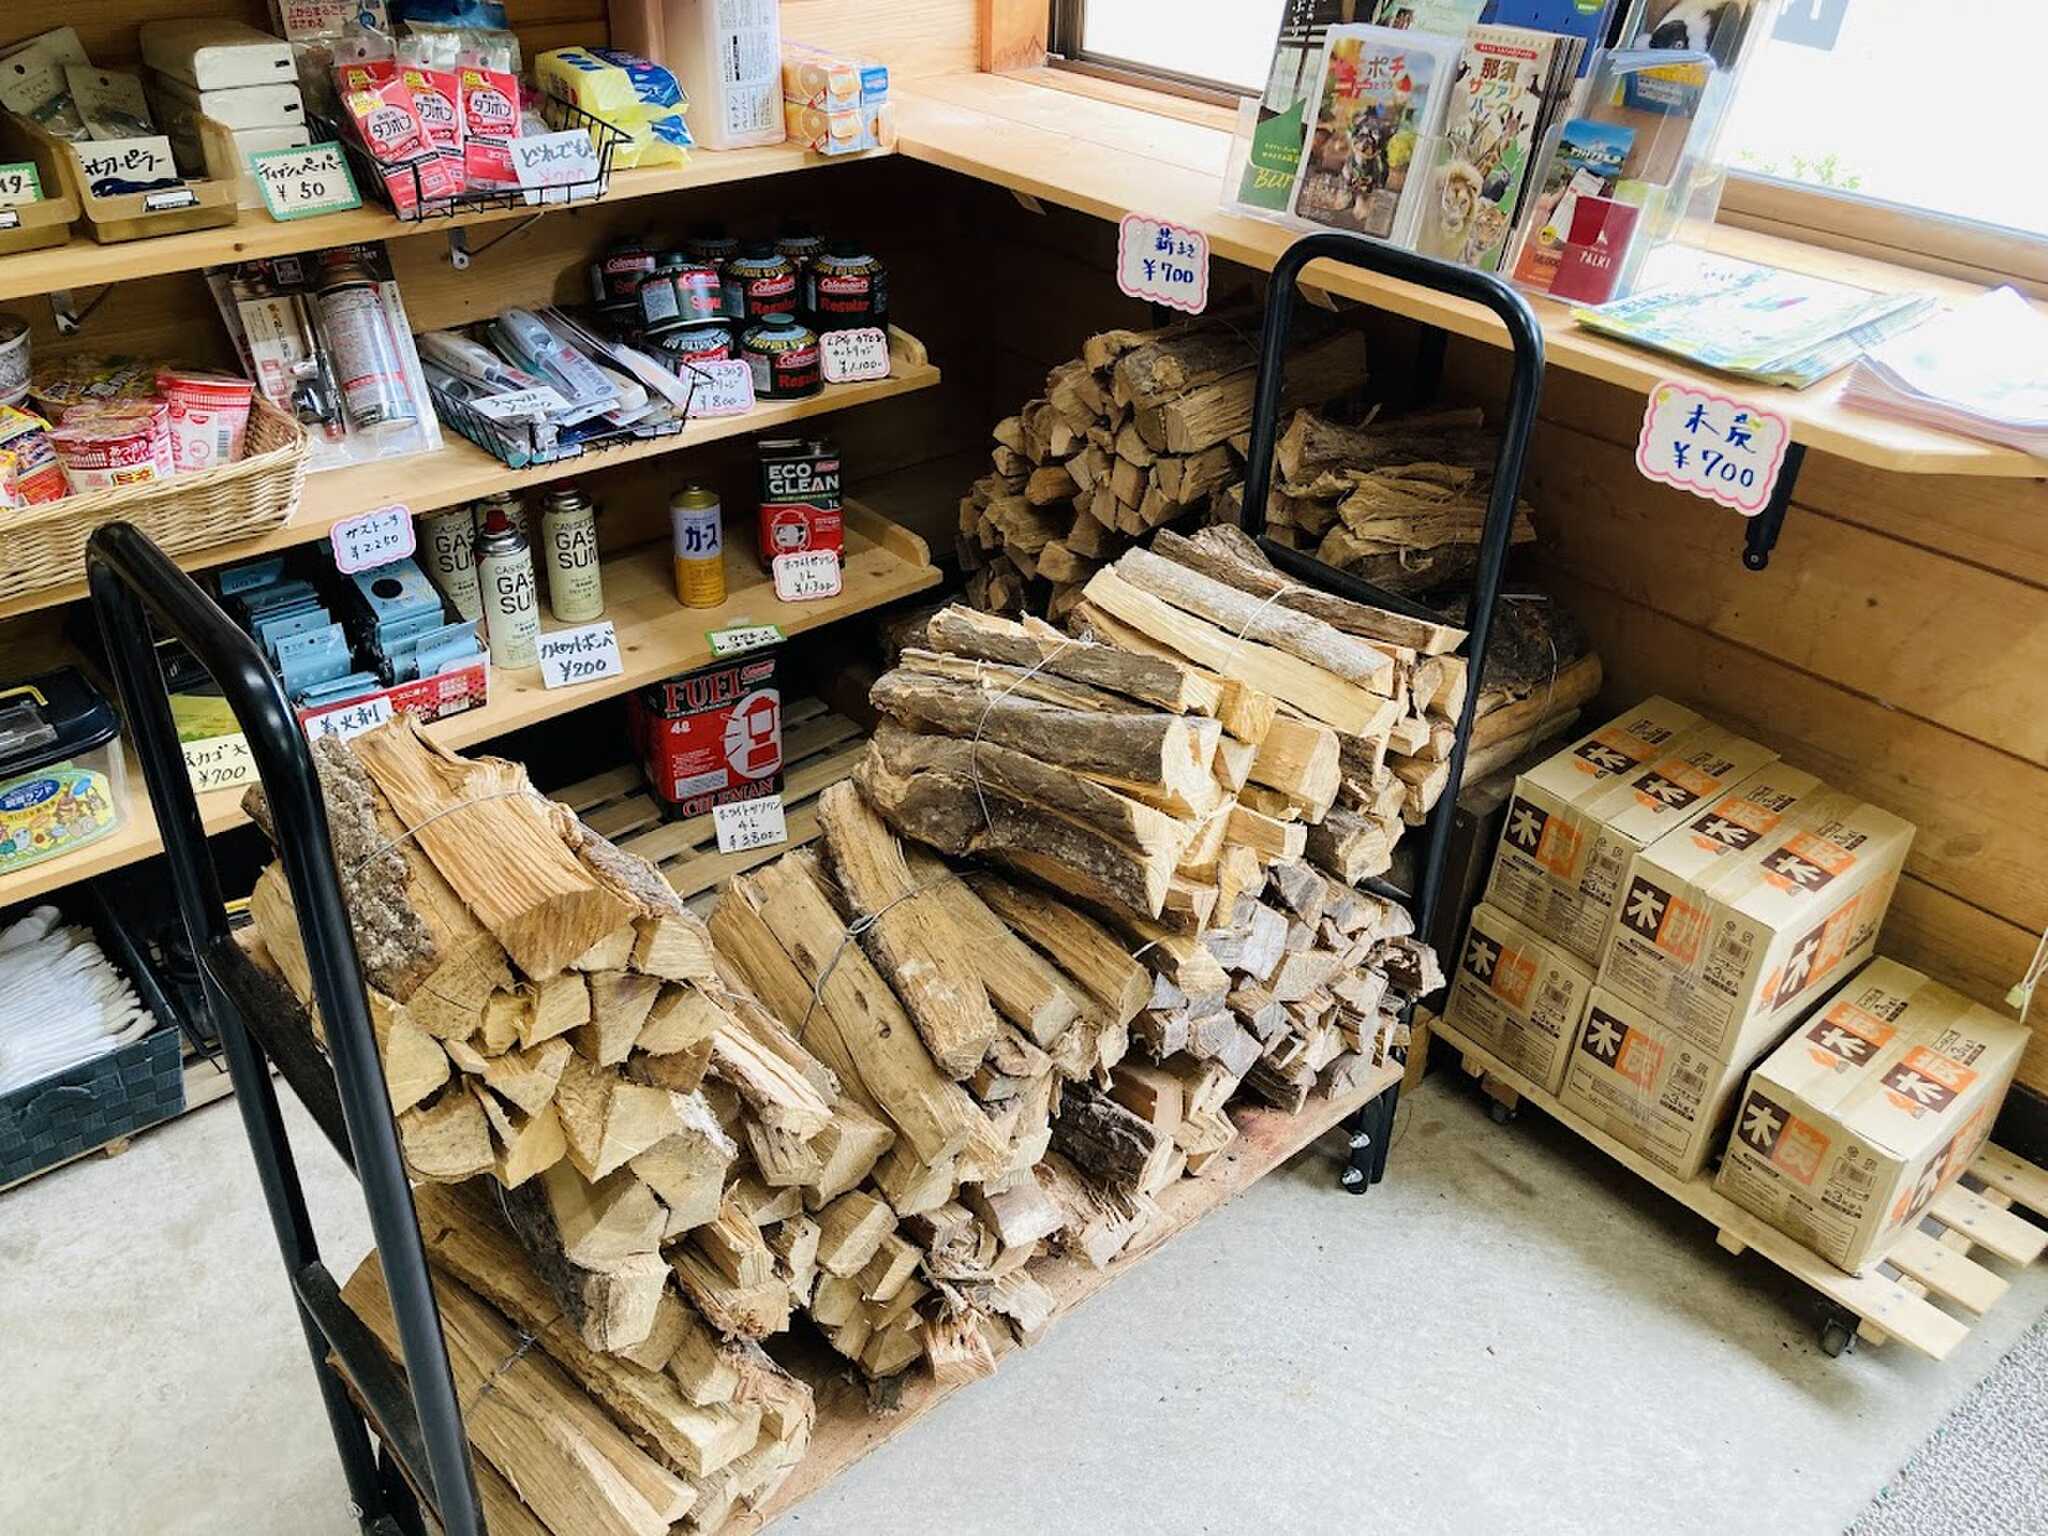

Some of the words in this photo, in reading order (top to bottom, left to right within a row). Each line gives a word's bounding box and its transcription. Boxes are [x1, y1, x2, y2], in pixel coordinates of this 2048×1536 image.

[1143, 258, 1194, 283] ¥700
[1685, 403, 1756, 455] 木炭
[768, 463, 812, 480] ECO
[1673, 441, 1754, 488] ¥700
[769, 474, 840, 495] CLEAN
[555, 527, 596, 551] GAS
[438, 552, 475, 574] SU
[559, 659, 607, 682] ¥200
[663, 666, 749, 714] FUEL
[199, 766, 247, 788] ¥700
